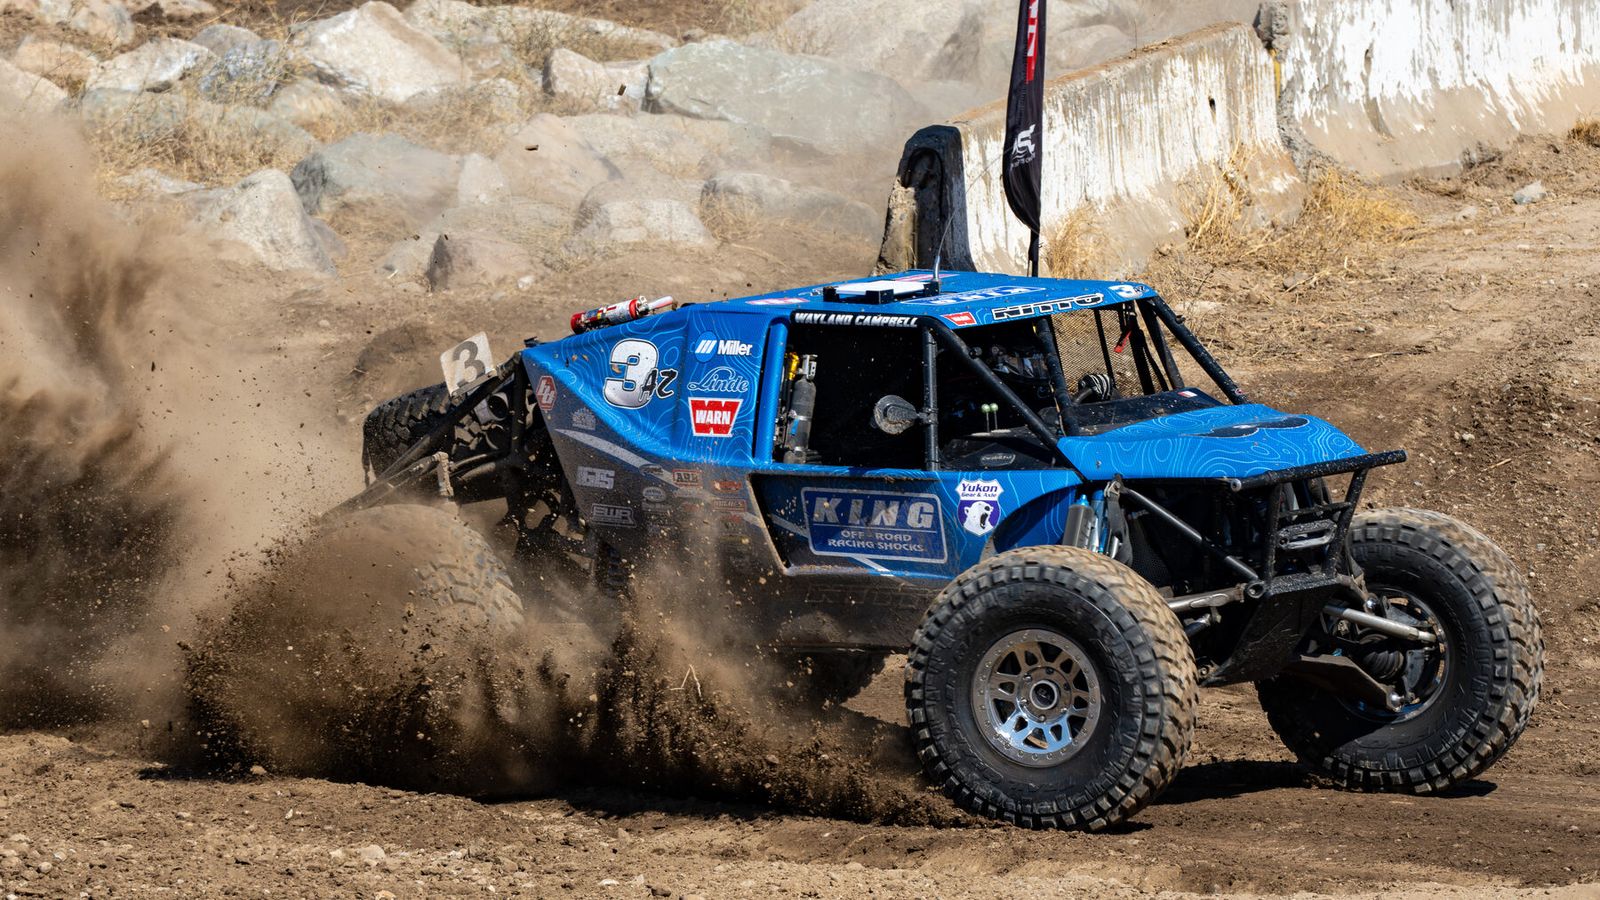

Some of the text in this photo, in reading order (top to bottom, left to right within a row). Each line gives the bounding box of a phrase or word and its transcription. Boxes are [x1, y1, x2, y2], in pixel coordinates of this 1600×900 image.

[1108, 284, 1143, 299] 3
[992, 293, 1104, 321] NITTO
[795, 312, 918, 328] WAYLAND CAMPBELL
[717, 340, 753, 356] Miller
[452, 341, 486, 388] 3
[603, 338, 659, 410] 3
[687, 366, 749, 393] Linde
[695, 409, 731, 425] WARN
[961, 483, 998, 493] Yukon
[812, 496, 936, 530] KING
[840, 529, 865, 539] OFF
[875, 532, 912, 542] ROAD
[827, 539, 926, 552] RACING SHOCKS
